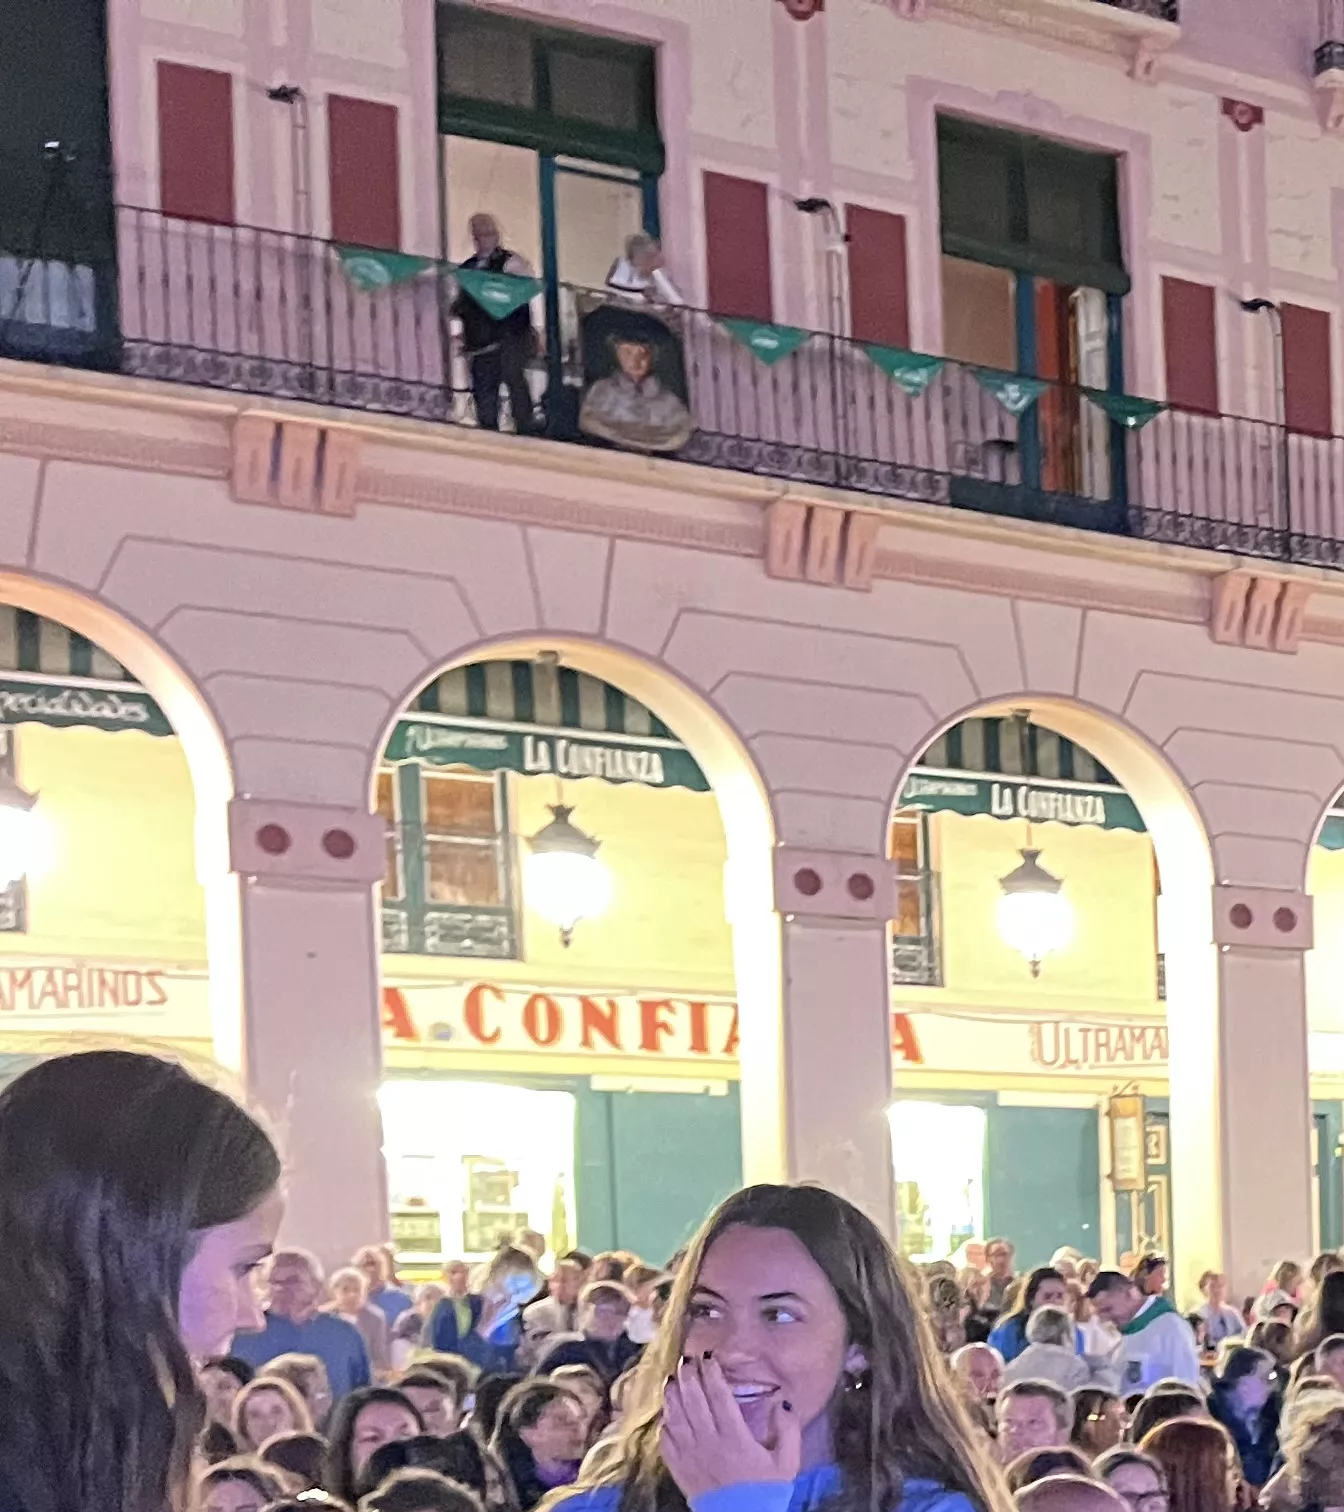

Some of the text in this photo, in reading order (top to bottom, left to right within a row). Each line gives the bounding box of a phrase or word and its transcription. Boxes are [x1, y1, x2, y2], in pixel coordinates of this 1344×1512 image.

[522, 735, 549, 771] LA
[555, 738, 665, 785] CONFIANZA
[991, 783, 1014, 816] LA
[1016, 785, 1107, 825] CONFIANZA
